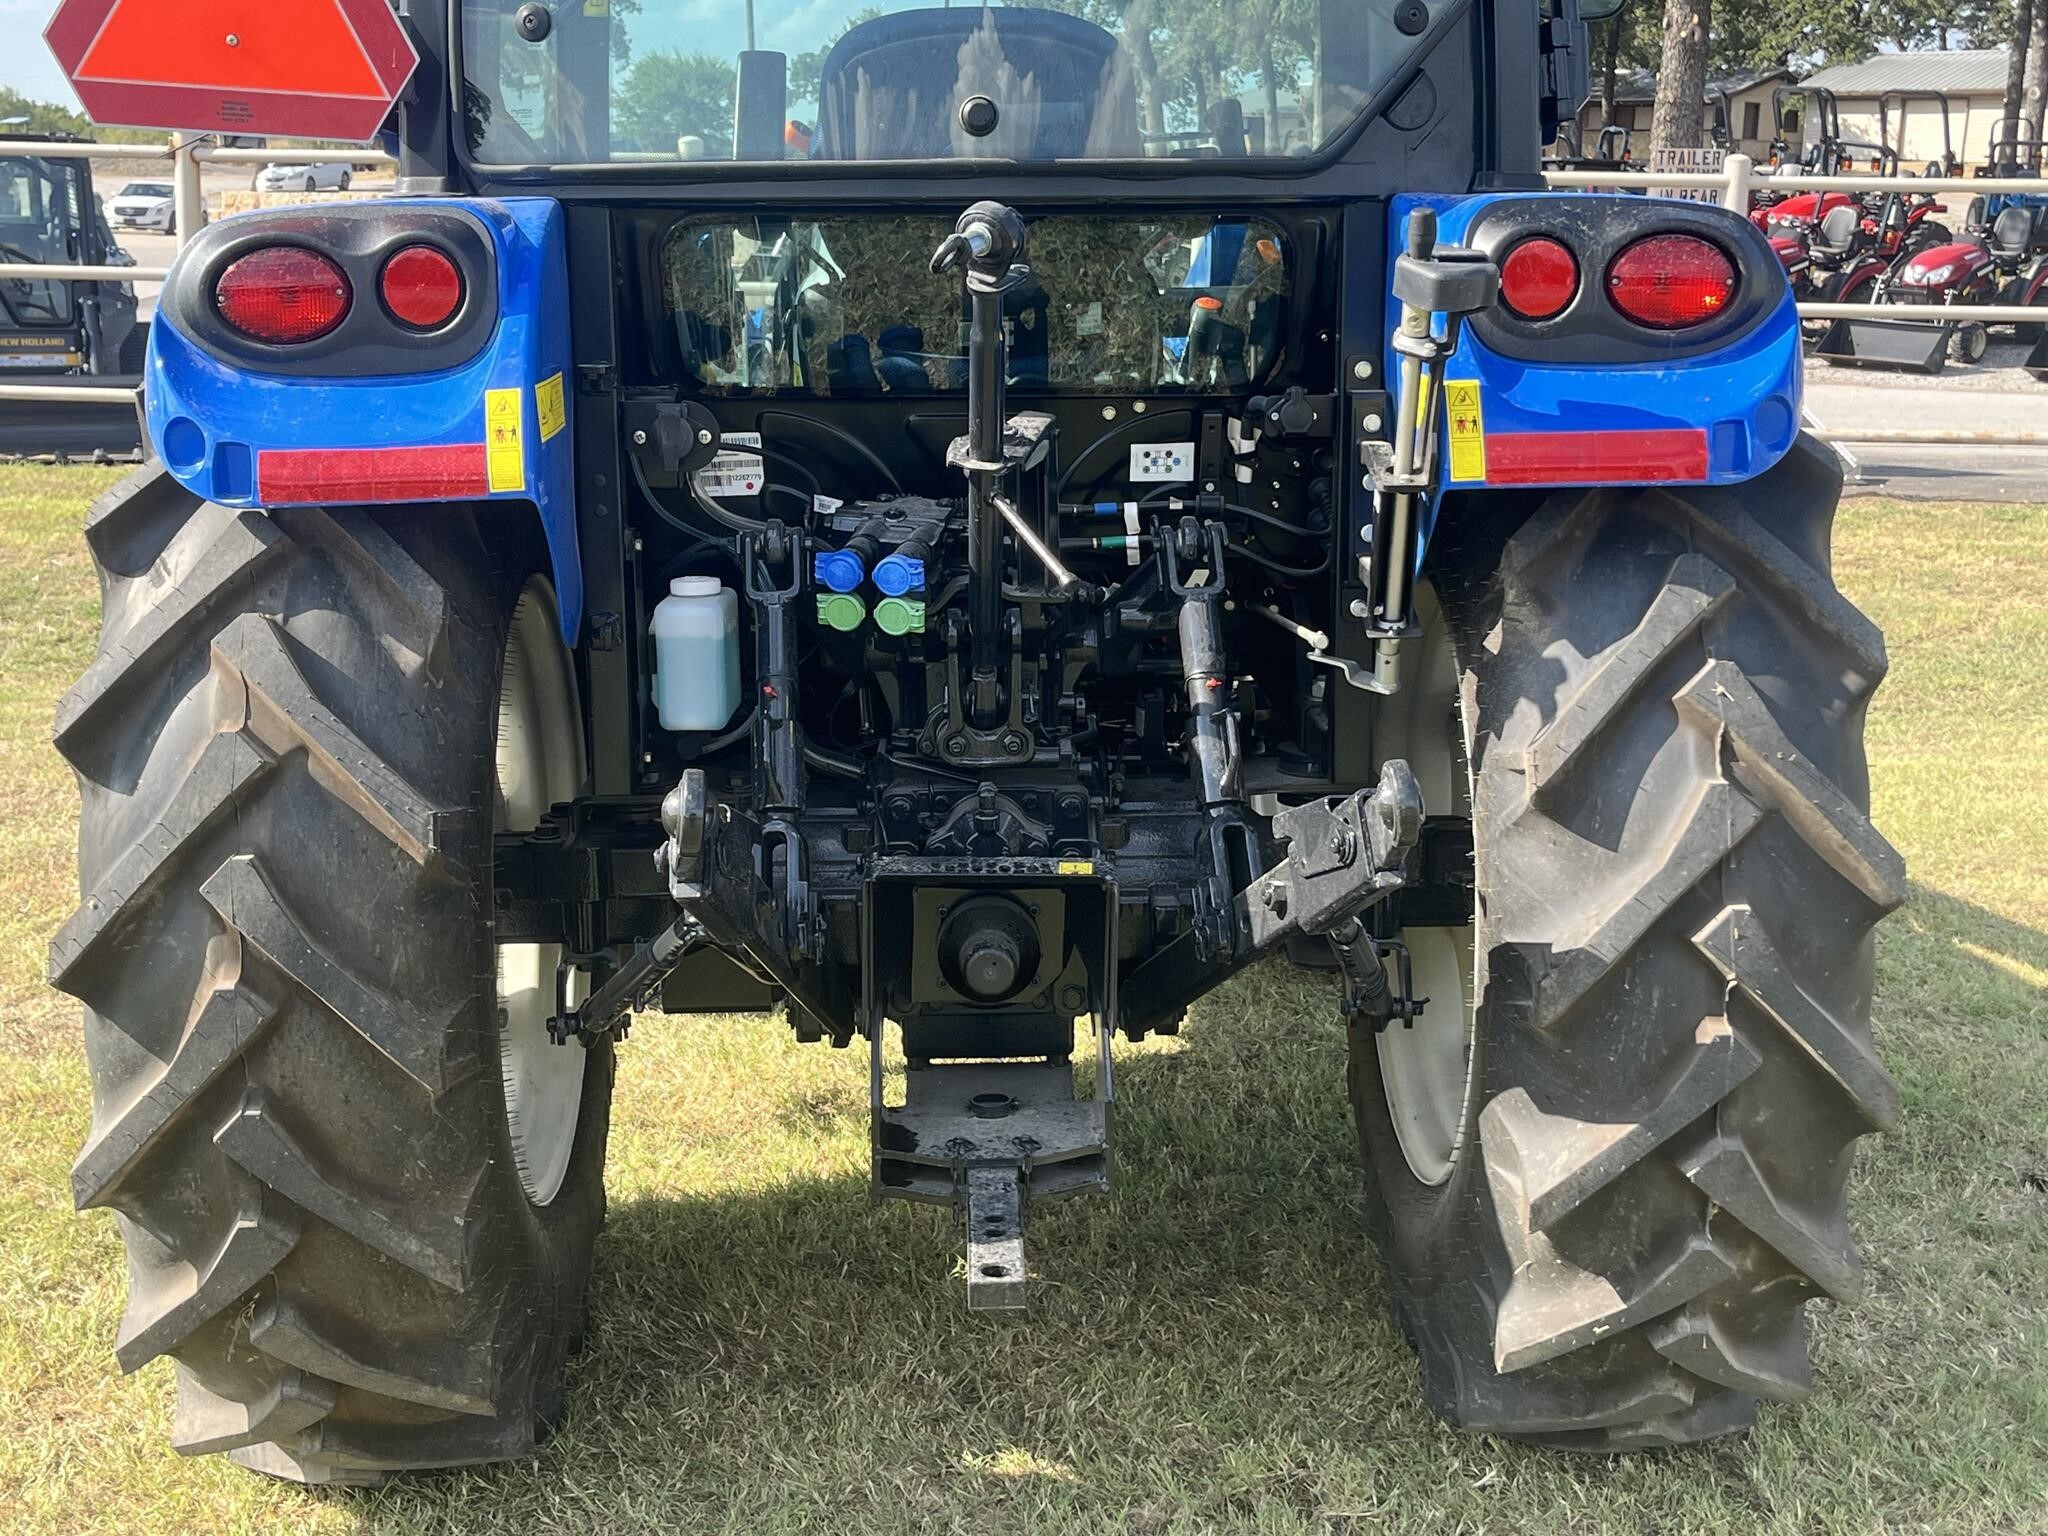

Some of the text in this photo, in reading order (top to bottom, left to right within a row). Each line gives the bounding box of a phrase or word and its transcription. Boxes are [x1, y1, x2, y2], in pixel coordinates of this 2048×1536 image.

[1658, 150, 1721, 166] TRAILER
[1680, 189, 1718, 204] REAR
[21, 338, 65, 346] HOLLAND
